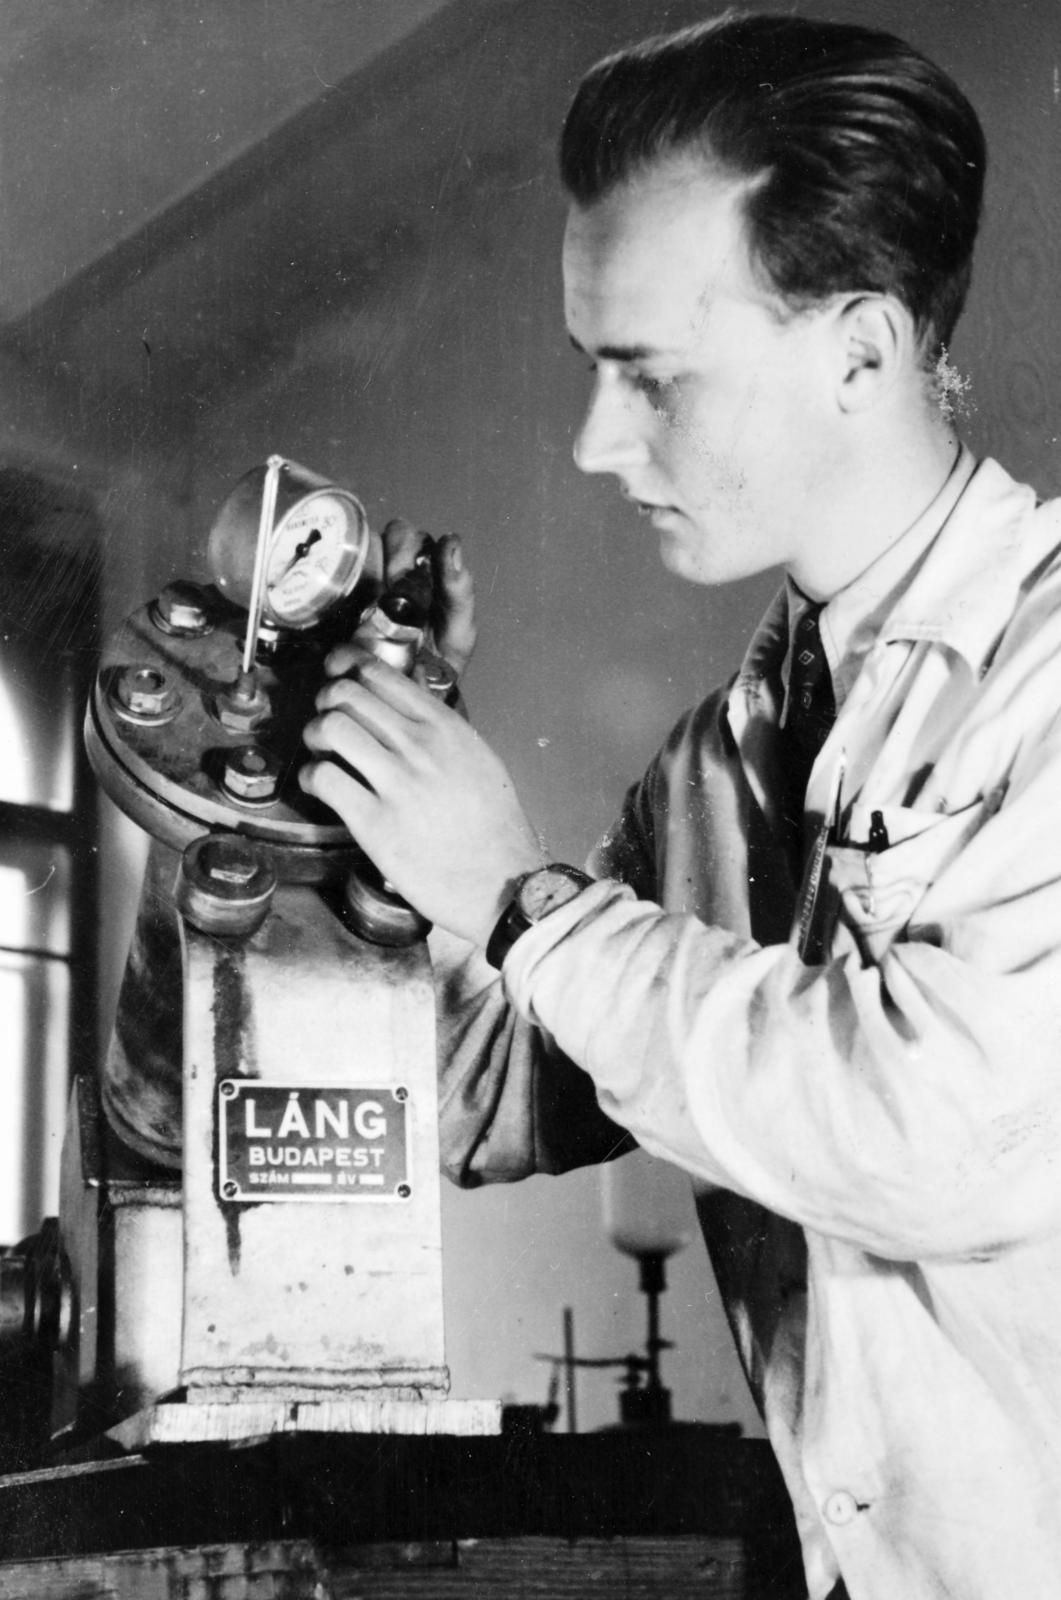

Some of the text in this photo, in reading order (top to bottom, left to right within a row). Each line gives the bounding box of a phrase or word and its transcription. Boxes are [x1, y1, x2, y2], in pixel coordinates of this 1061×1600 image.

[245, 1092, 387, 1139] LÁNG
[249, 1146, 385, 1167] BUDAPEST
[249, 1170, 356, 1185] SZÁM ÉV
